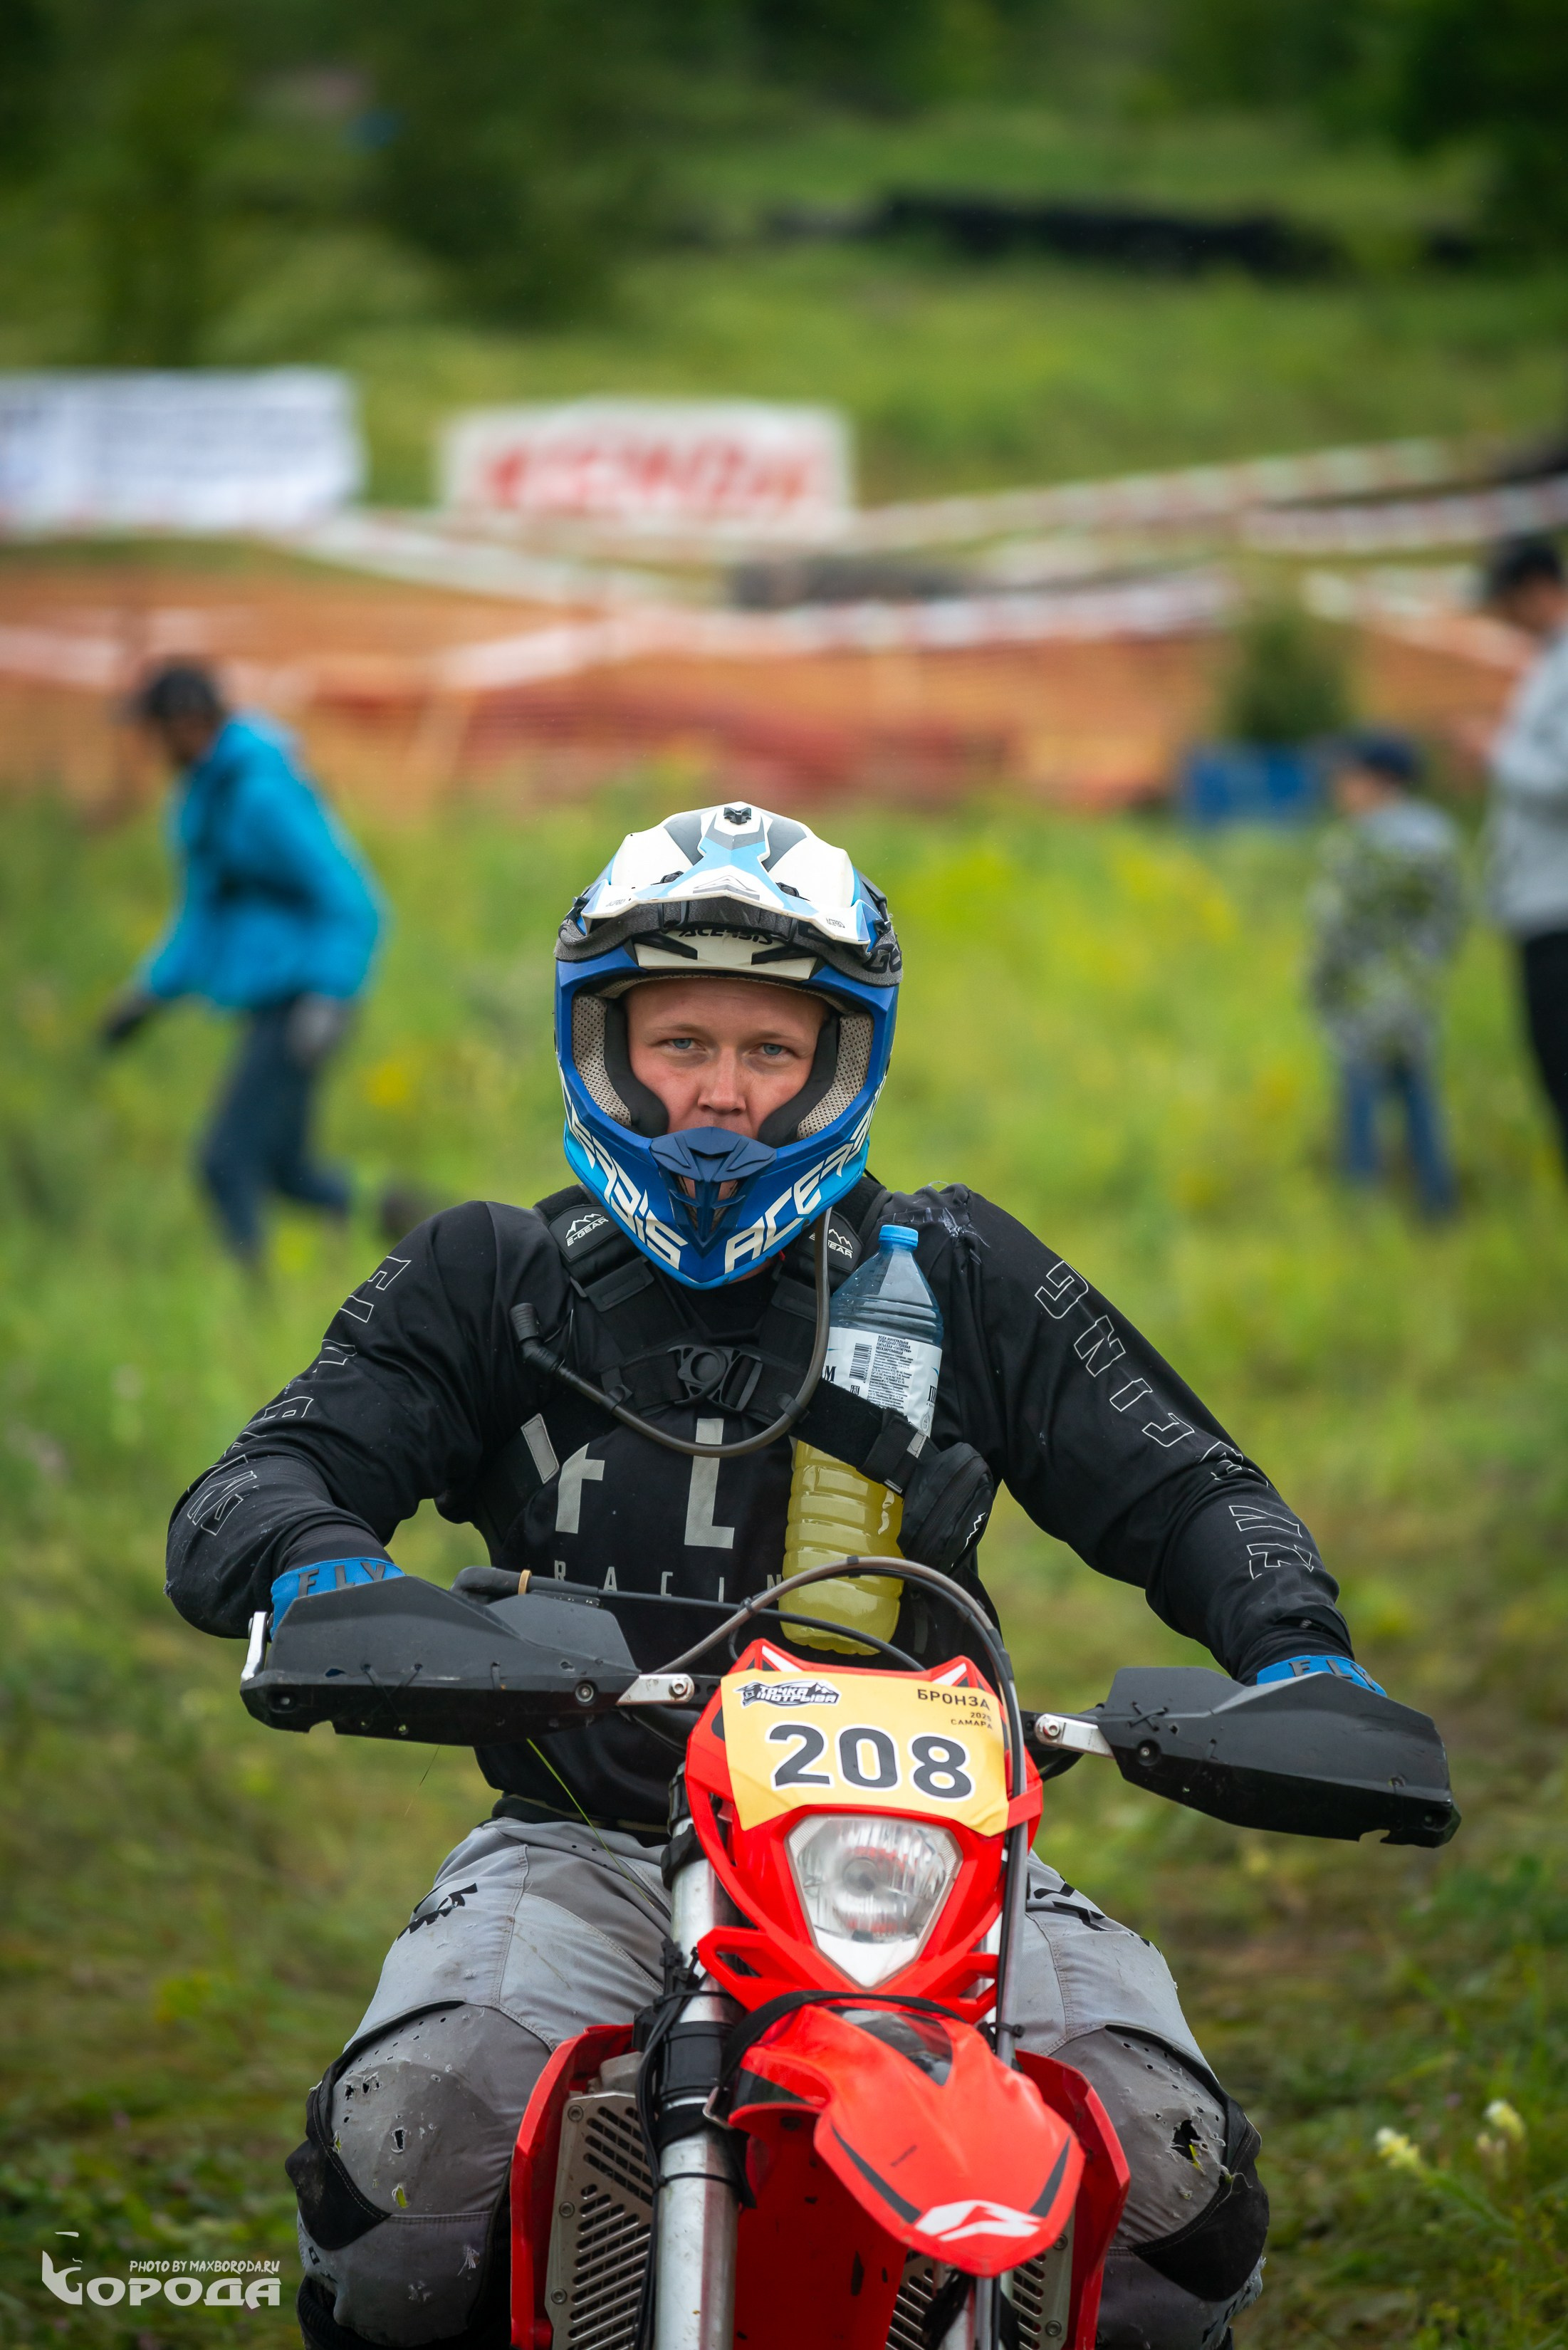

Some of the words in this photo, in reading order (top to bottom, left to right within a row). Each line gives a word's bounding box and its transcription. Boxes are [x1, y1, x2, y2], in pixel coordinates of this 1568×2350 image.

[567, 1217, 610, 1247] E-GEAR
[808, 1232, 853, 1259] EEAR
[298, 1562, 386, 1598] FLY
[917, 1688, 991, 1711] БРОНЗА
[951, 1719, 993, 1730] САМАРА
[970, 1712, 992, 1723] 2025
[768, 1723, 973, 1800] 208
